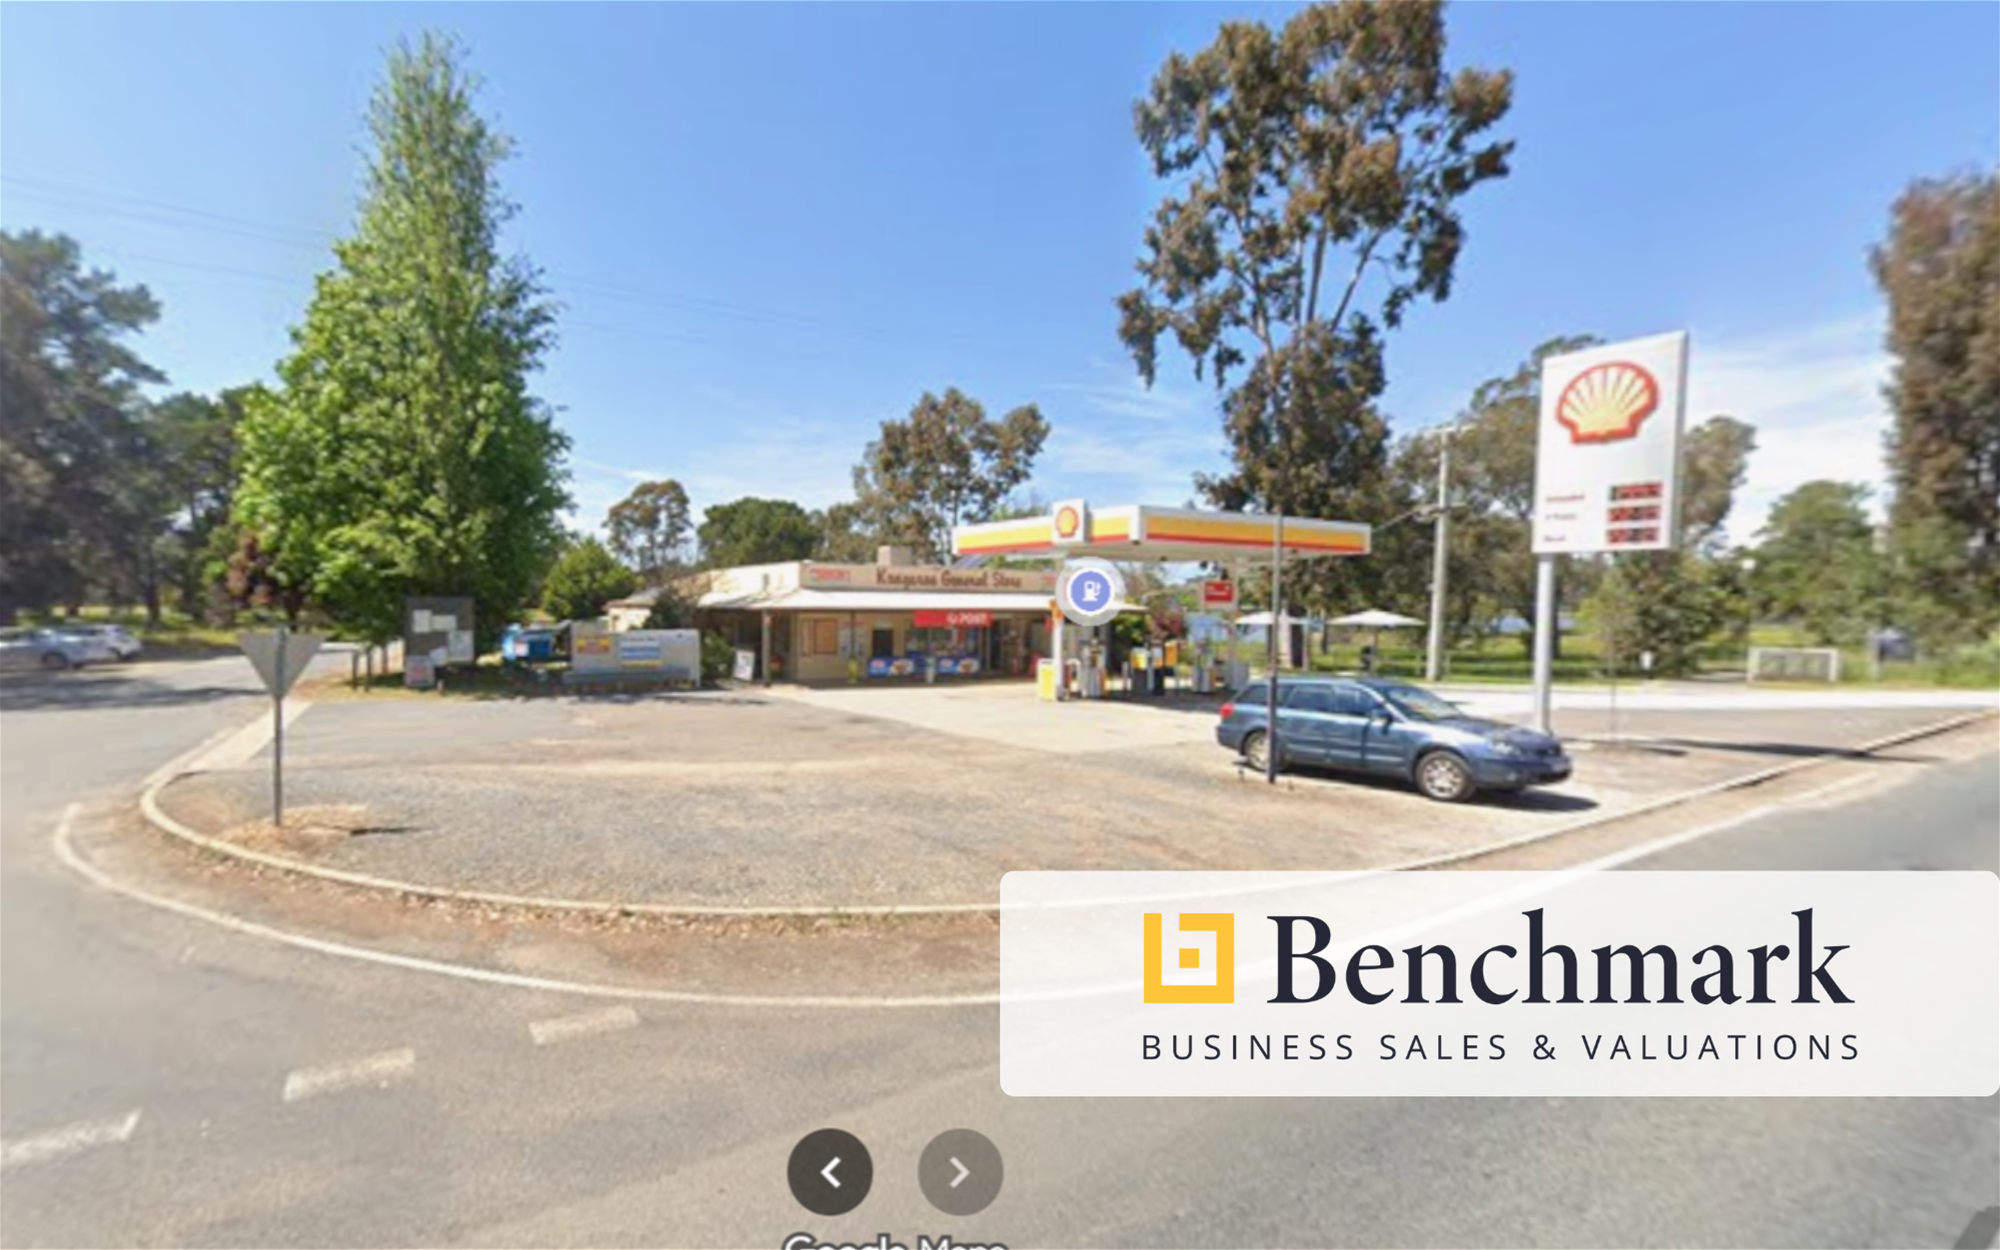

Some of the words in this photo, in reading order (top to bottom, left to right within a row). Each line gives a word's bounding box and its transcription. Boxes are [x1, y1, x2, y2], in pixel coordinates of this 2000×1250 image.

[940, 569, 988, 588] General
[992, 571, 1022, 588] Store
[959, 611, 988, 625] POST
